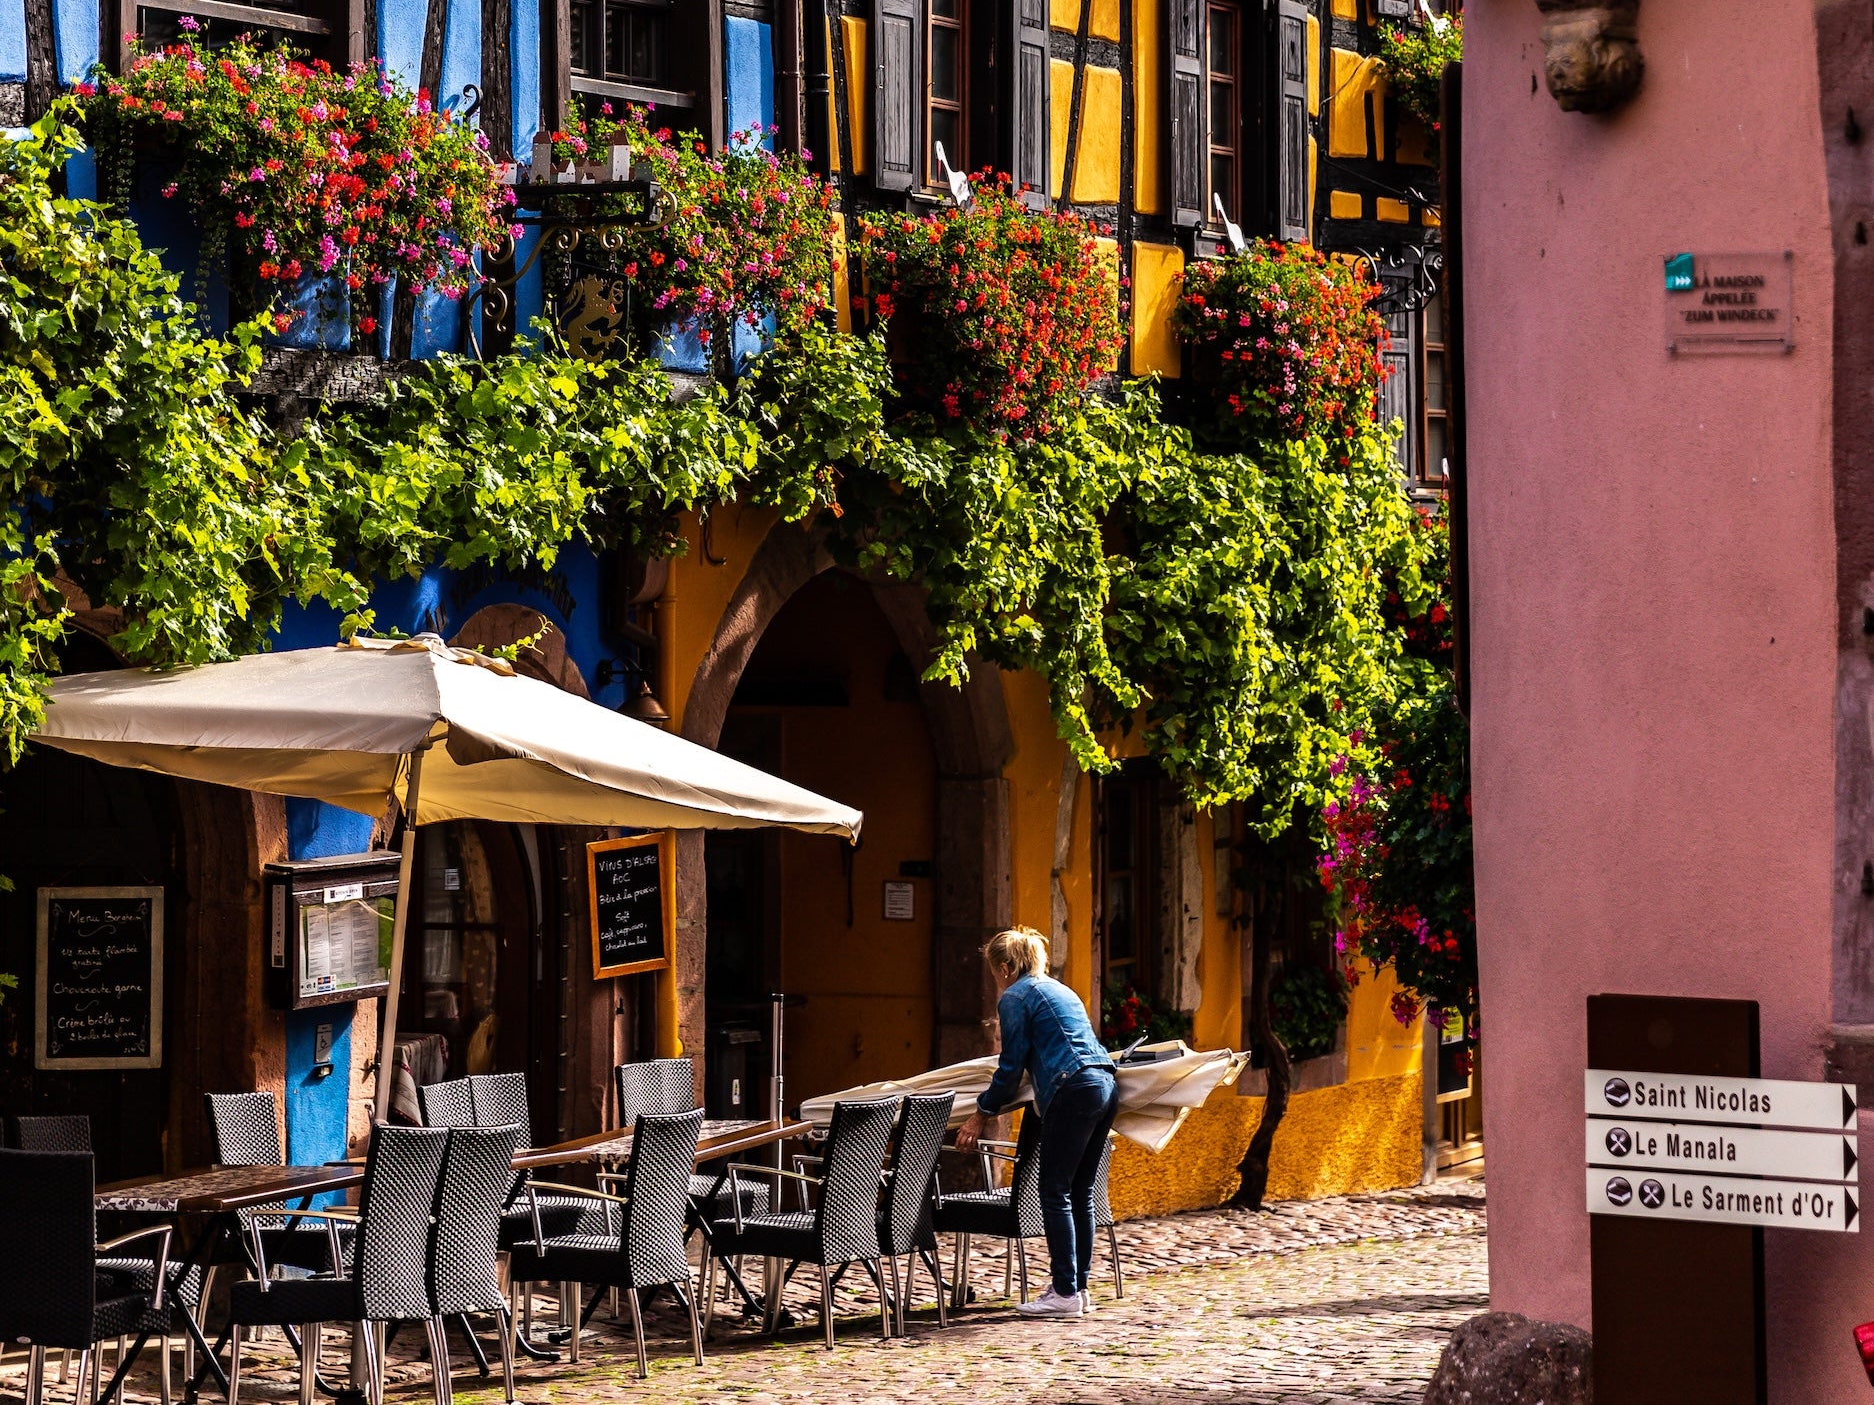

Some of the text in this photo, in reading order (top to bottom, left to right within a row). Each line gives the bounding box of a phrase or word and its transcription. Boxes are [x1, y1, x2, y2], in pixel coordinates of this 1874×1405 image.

[1714, 275, 1765, 288] MAISON
[68, 909, 101, 925] Menu
[1634, 1081, 1772, 1113] Saint Nicolas
[1635, 1131, 1737, 1161] Le Manala
[1672, 1183, 1834, 1218] Le Sarment d'Or
